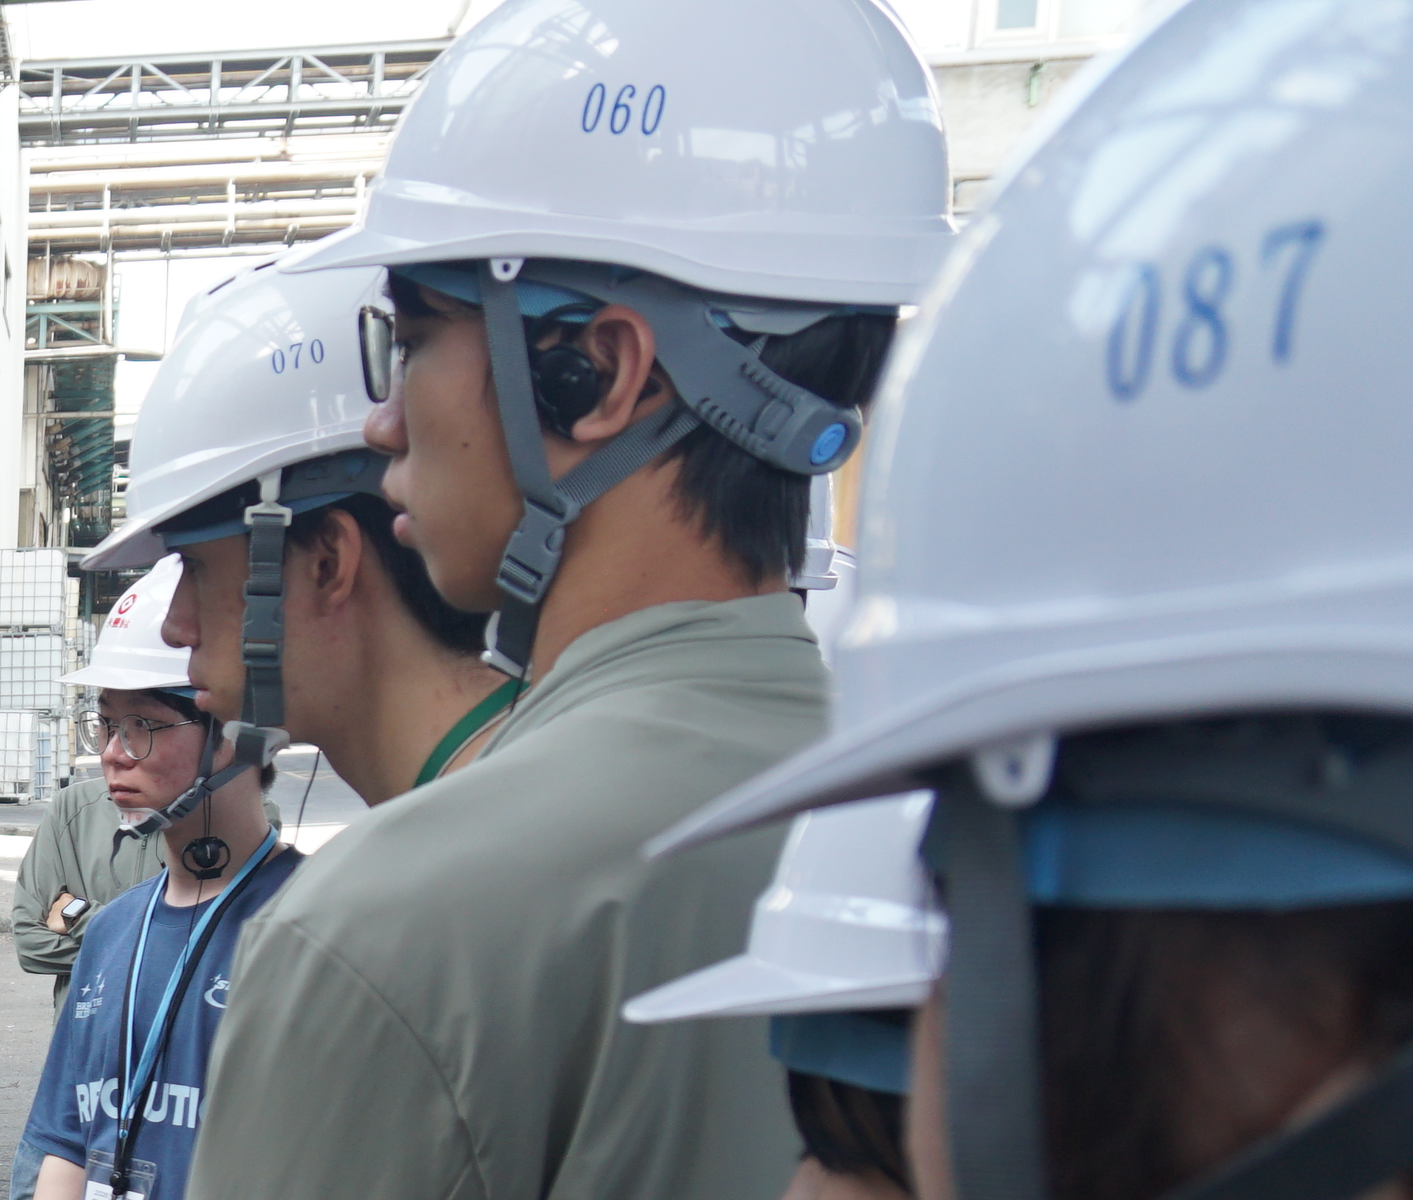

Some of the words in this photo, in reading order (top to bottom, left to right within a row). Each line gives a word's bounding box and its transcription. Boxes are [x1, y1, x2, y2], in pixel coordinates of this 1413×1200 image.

[581, 82, 666, 136] 060
[1105, 220, 1325, 404] 087
[272, 338, 324, 374] 070
